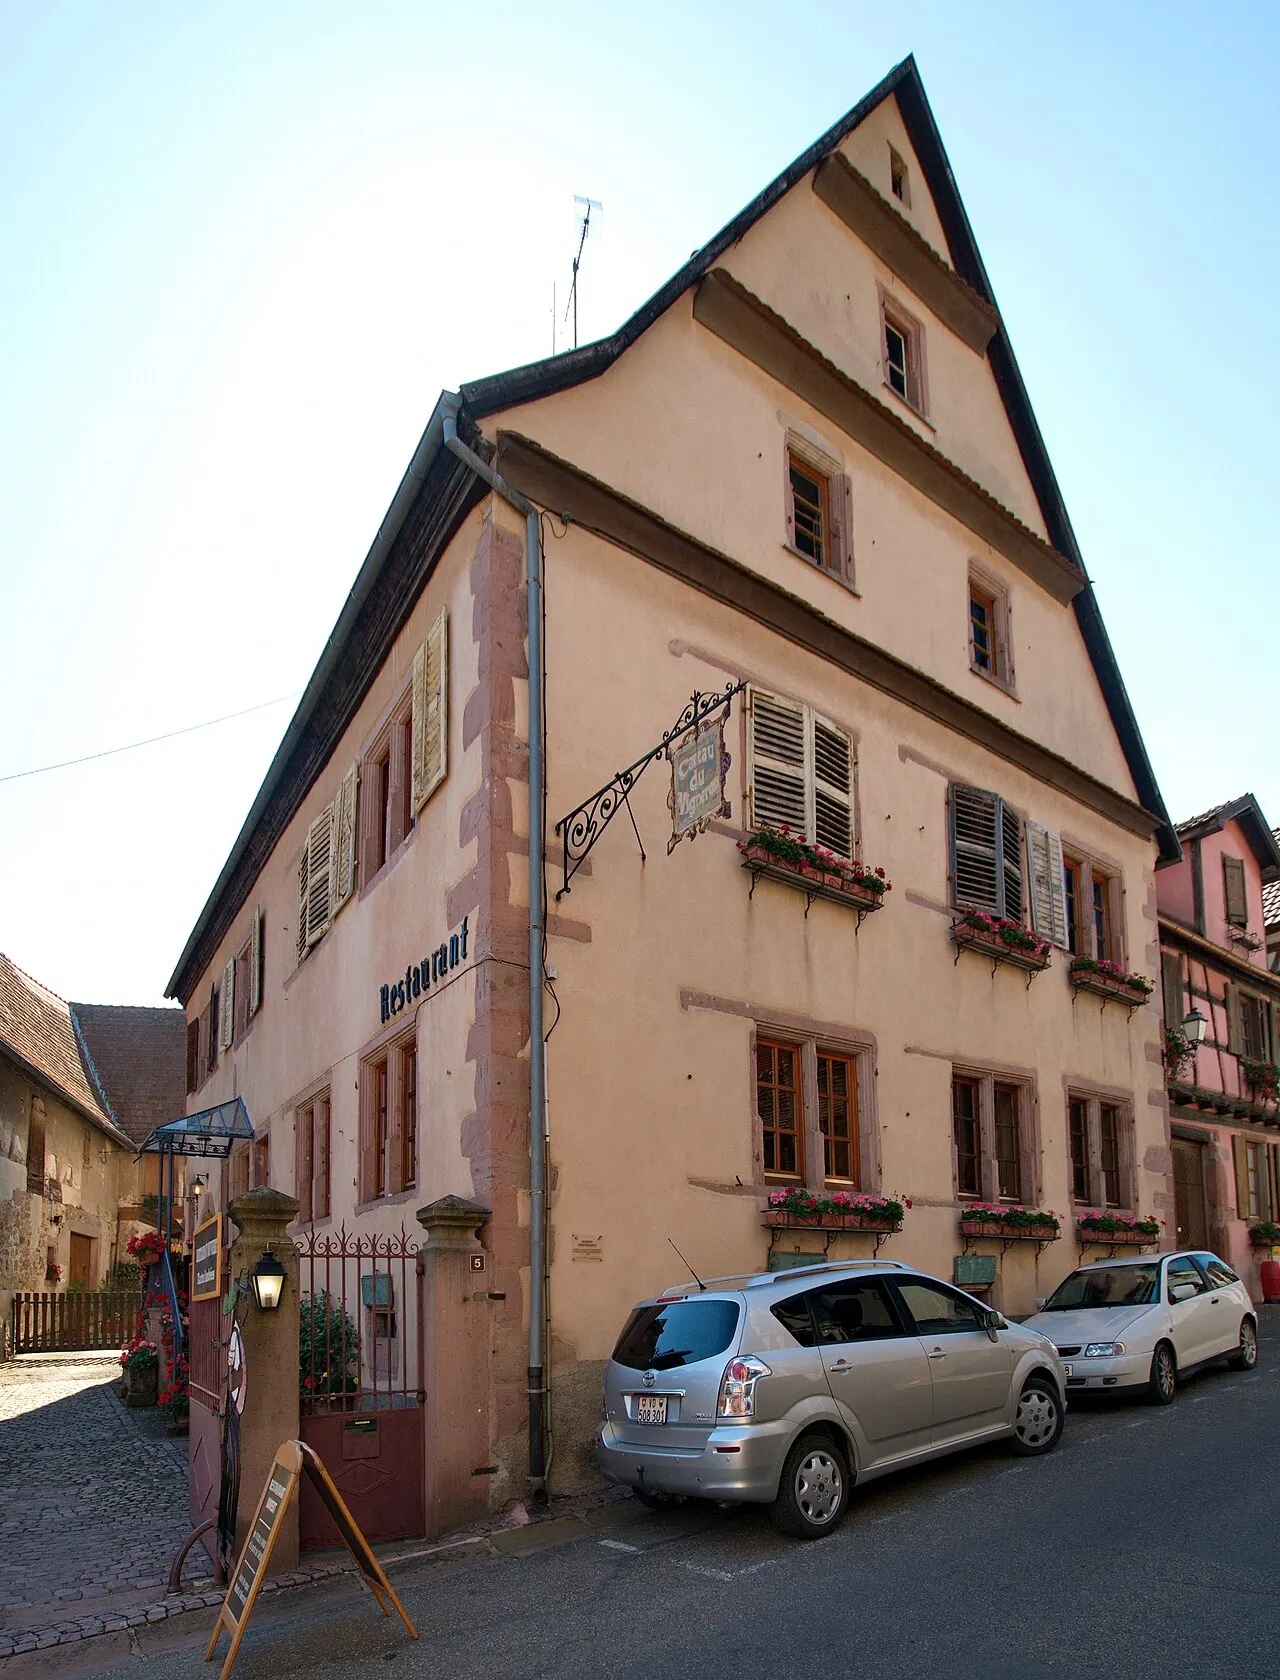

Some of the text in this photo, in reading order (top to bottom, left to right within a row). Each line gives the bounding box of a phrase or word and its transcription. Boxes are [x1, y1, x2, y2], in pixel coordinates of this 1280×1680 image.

[380, 916, 469, 1024] Restaurant
[474, 1258, 481, 1268] 5
[649, 1398, 656, 1408] VD
[639, 1409, 664, 1422] 508 301
